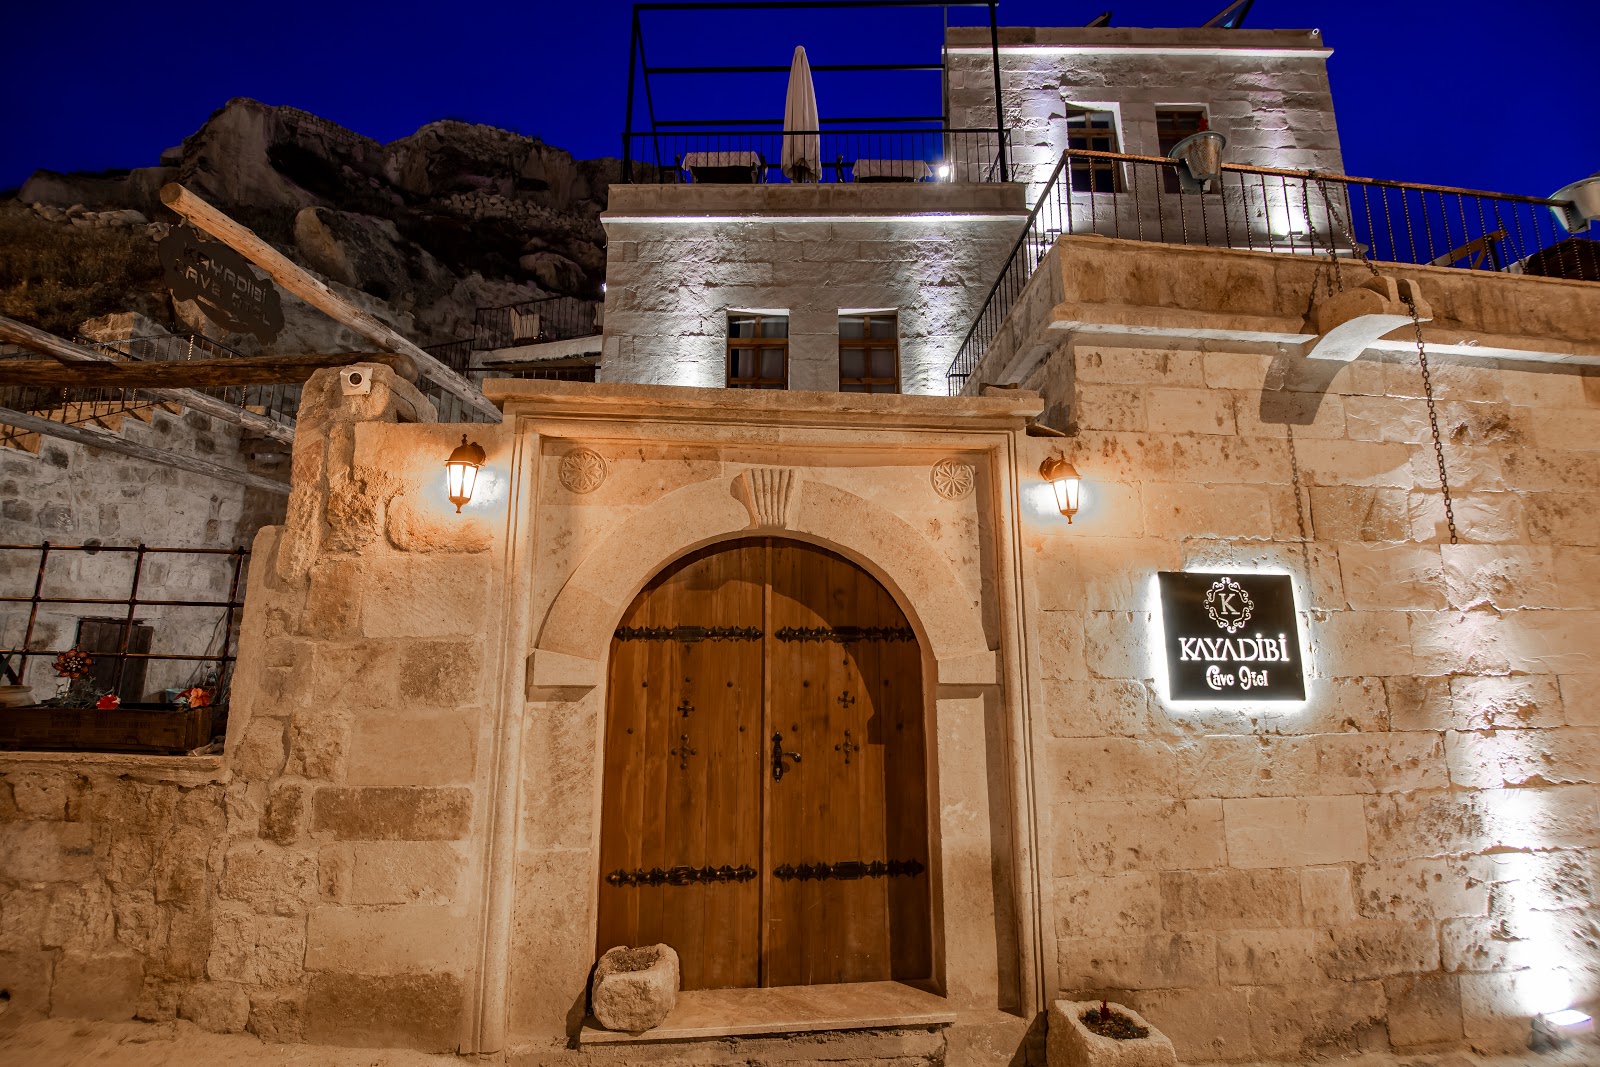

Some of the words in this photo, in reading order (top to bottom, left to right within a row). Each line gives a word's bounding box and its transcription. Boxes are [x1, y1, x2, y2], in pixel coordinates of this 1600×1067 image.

[1218, 593, 1241, 615] K
[1206, 665, 1235, 690] Cave
[1238, 665, 1269, 690] Otel
